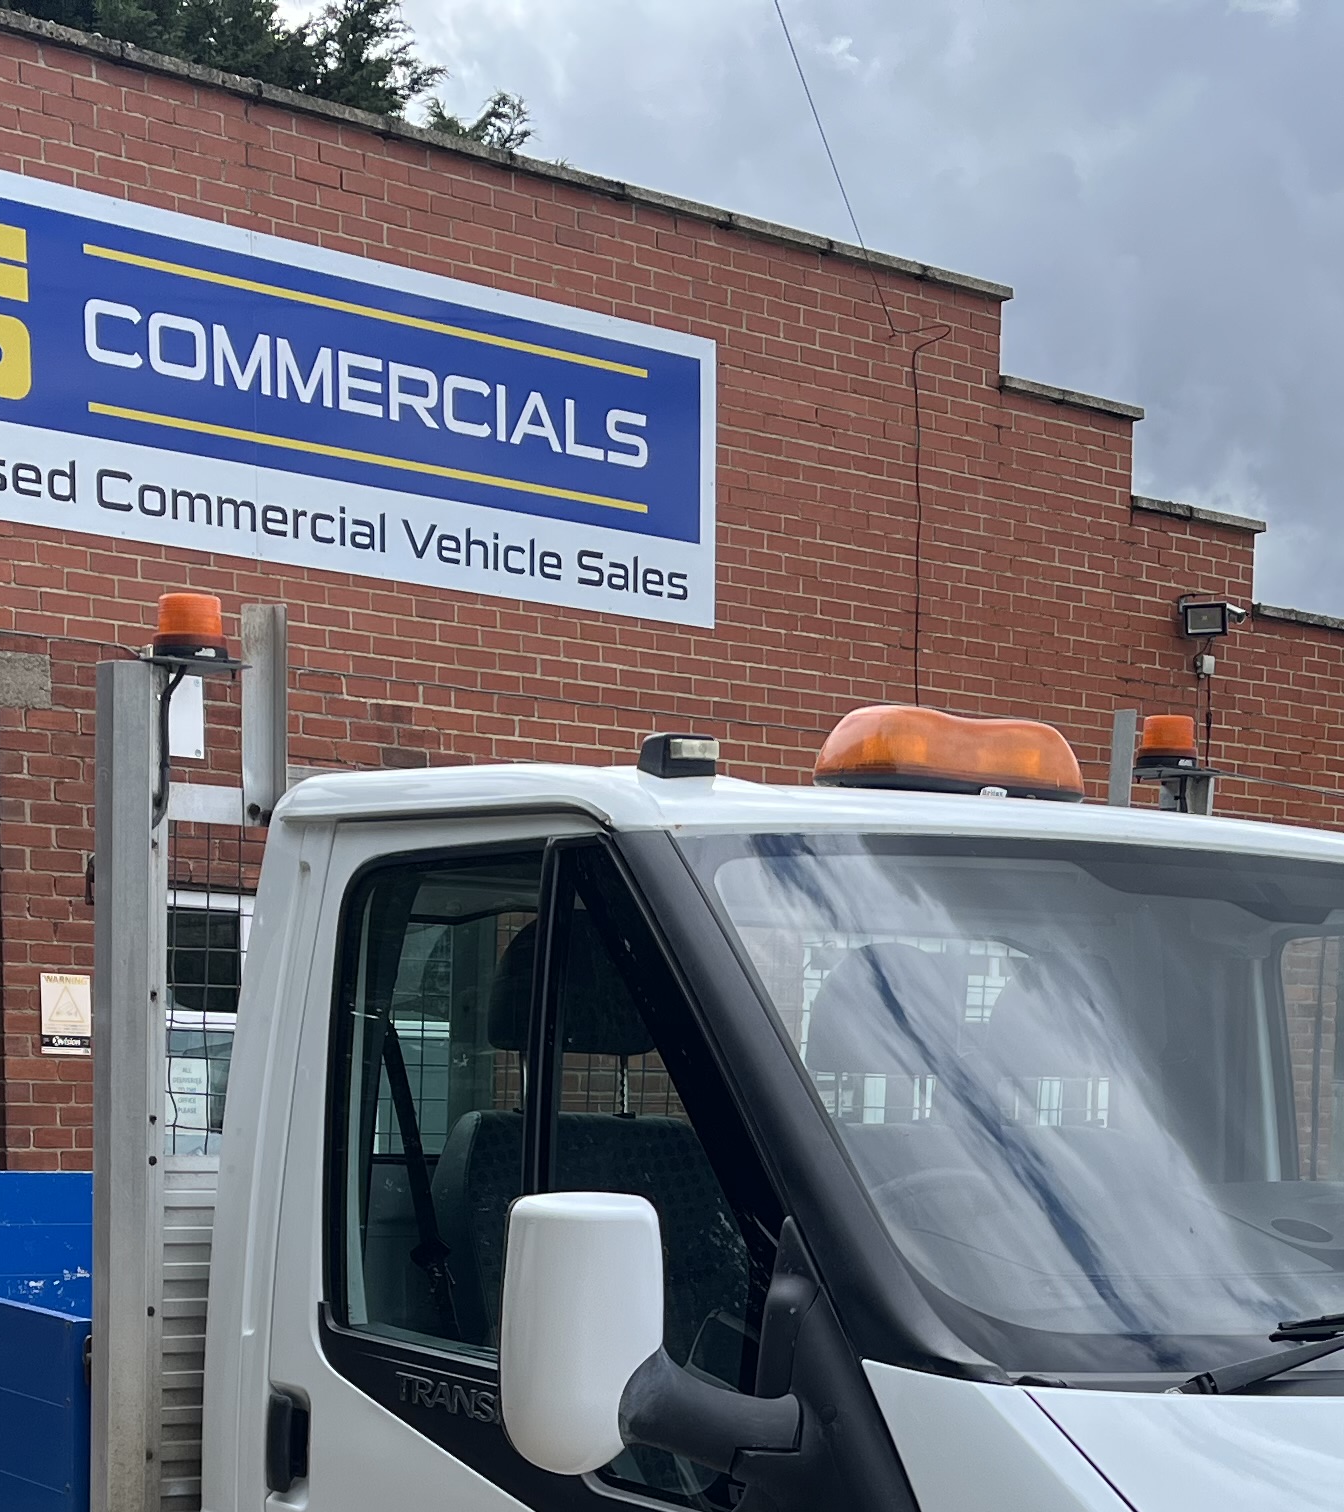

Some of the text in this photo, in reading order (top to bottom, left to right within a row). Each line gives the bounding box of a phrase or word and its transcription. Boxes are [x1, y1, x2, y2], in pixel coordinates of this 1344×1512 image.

[84, 298, 649, 468] COMMERCIALS
[96, 467, 386, 554] Commercial
[401, 517, 562, 581] Vehicle
[577, 549, 689, 601] Sales
[44, 975, 88, 986] WARNING
